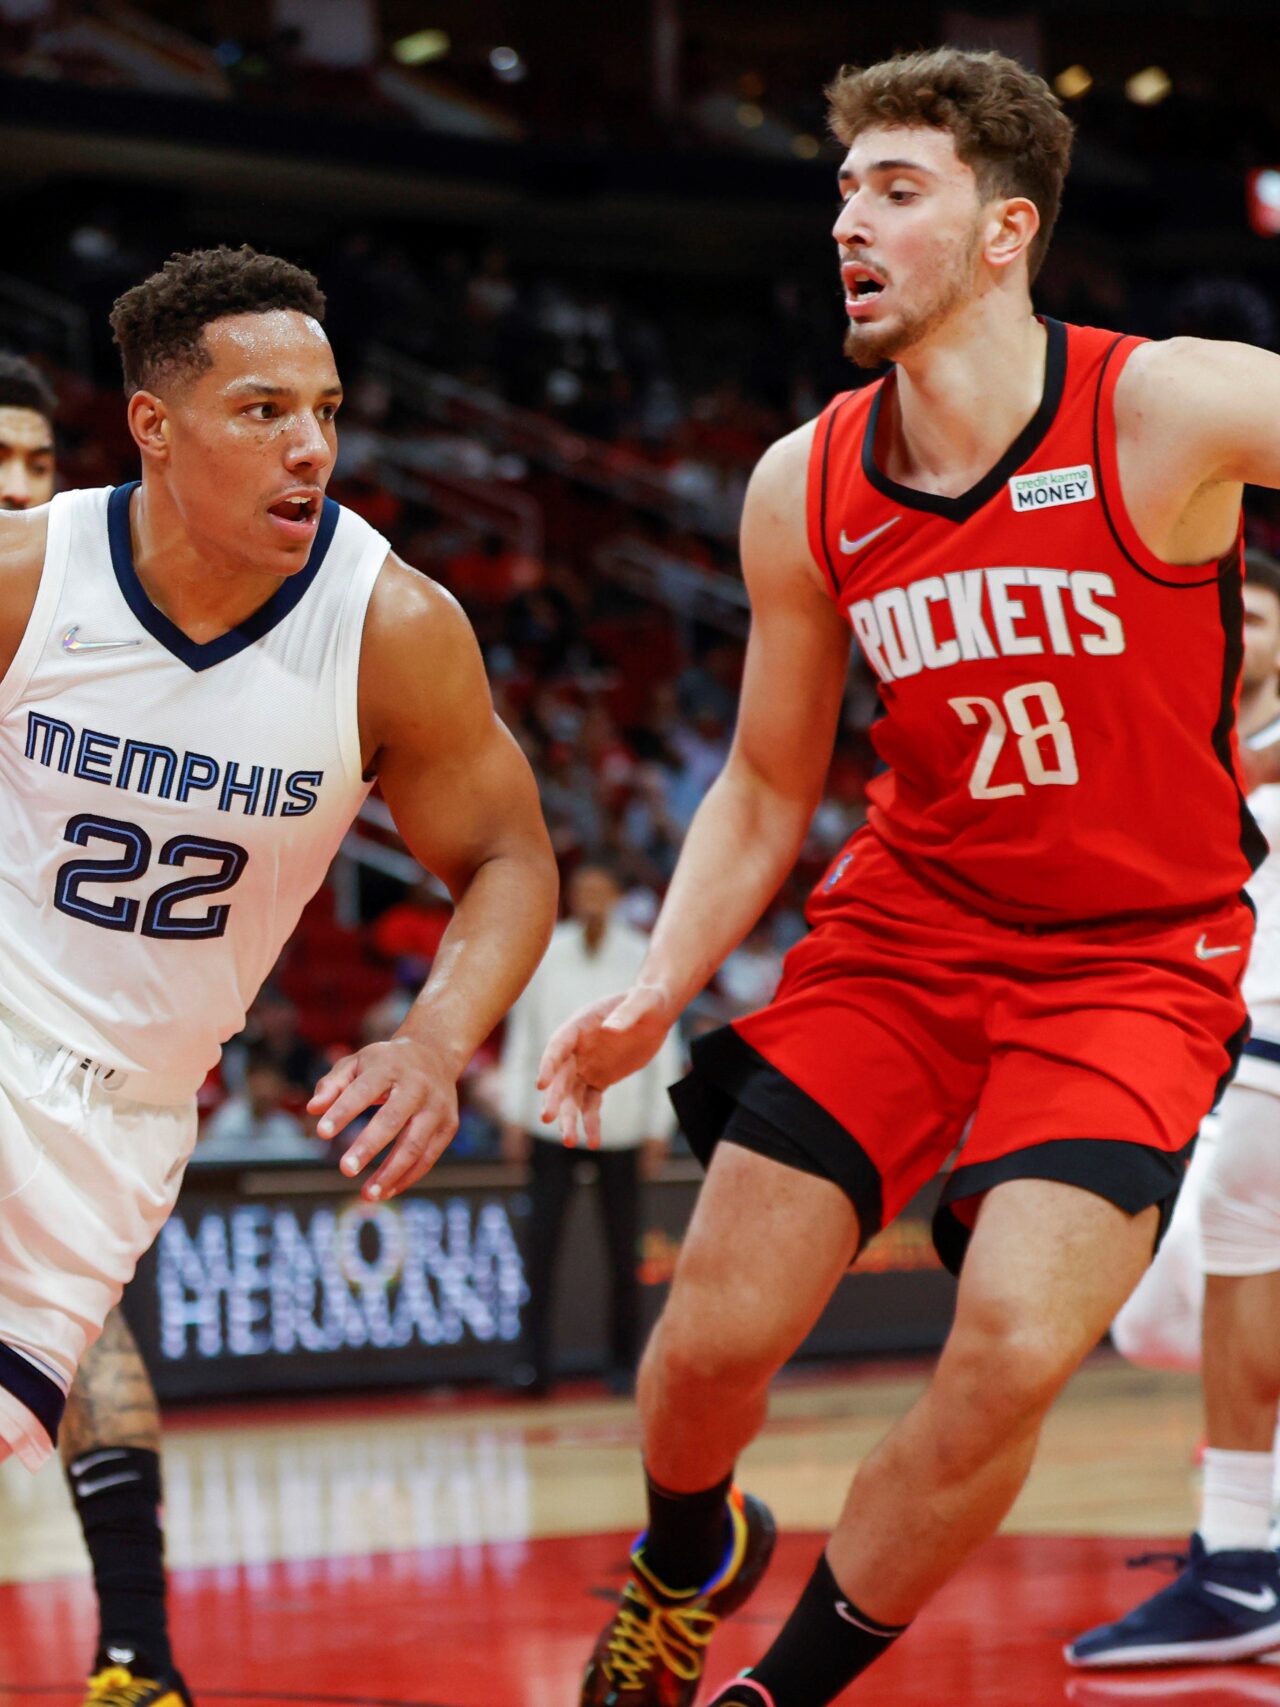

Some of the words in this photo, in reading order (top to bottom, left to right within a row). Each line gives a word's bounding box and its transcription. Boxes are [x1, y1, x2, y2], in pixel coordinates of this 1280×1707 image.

[1015, 475, 1047, 491] credit
[1050, 470, 1088, 484] karma
[1017, 481, 1088, 507] MONEY
[848, 566, 1126, 683] ROCKETS
[24, 711, 324, 817] MEMPHIS
[947, 681, 1079, 799] 28
[54, 813, 249, 940] 22
[158, 1198, 532, 1296] MEMORIA
